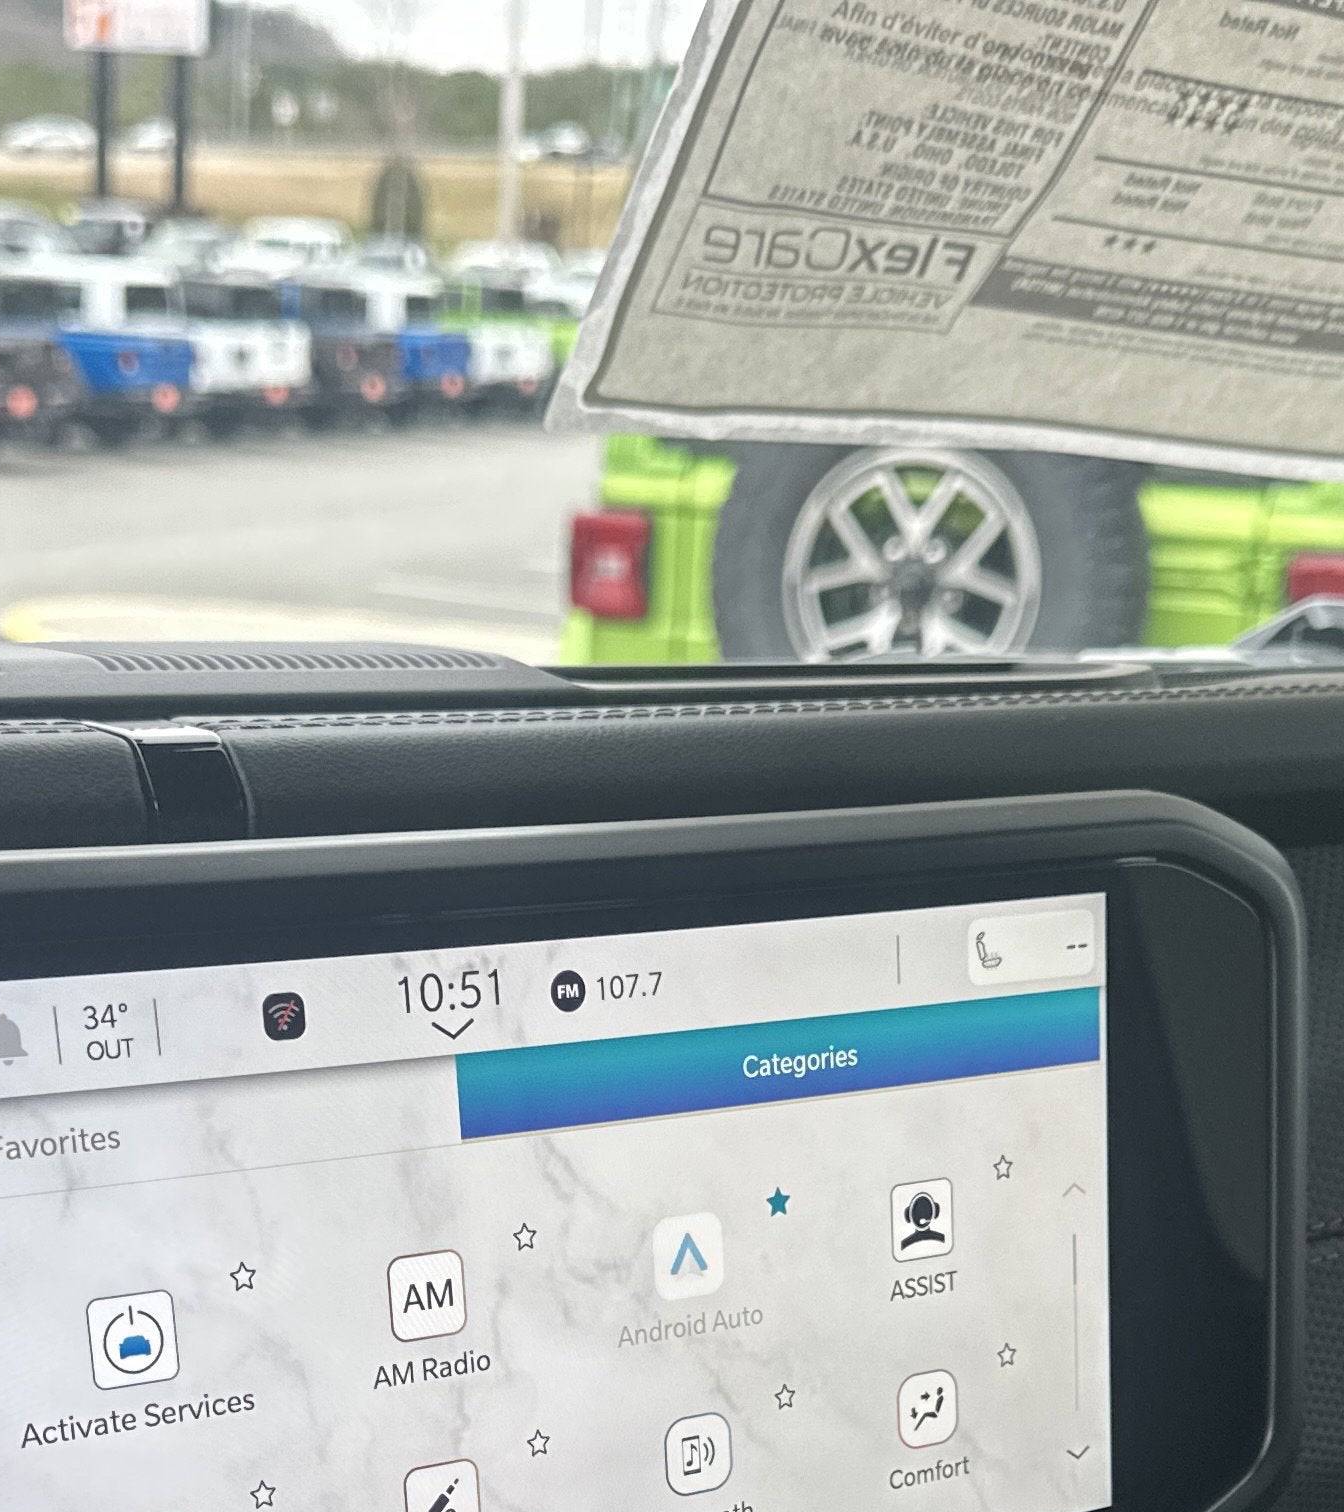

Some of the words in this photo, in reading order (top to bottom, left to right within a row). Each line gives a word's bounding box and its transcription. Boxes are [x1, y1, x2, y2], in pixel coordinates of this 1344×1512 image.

[397, 967, 503, 1015] 10:51
[556, 982, 580, 1001] FM
[596, 971, 664, 1003] 107.7
[86, 1037, 135, 1062] OUT
[742, 1044, 859, 1080] Categories
[402, 1277, 455, 1314] AM
[890, 1271, 958, 1302] ASSIST
[618, 1312, 707, 1349] Android
[712, 1307, 764, 1334] Auto
[373, 1361, 416, 1390] AM
[422, 1350, 492, 1381] Radio
[21, 1409, 138, 1449] Activate
[144, 1391, 256, 1428] Services
[889, 1456, 971, 1491] Comfort
